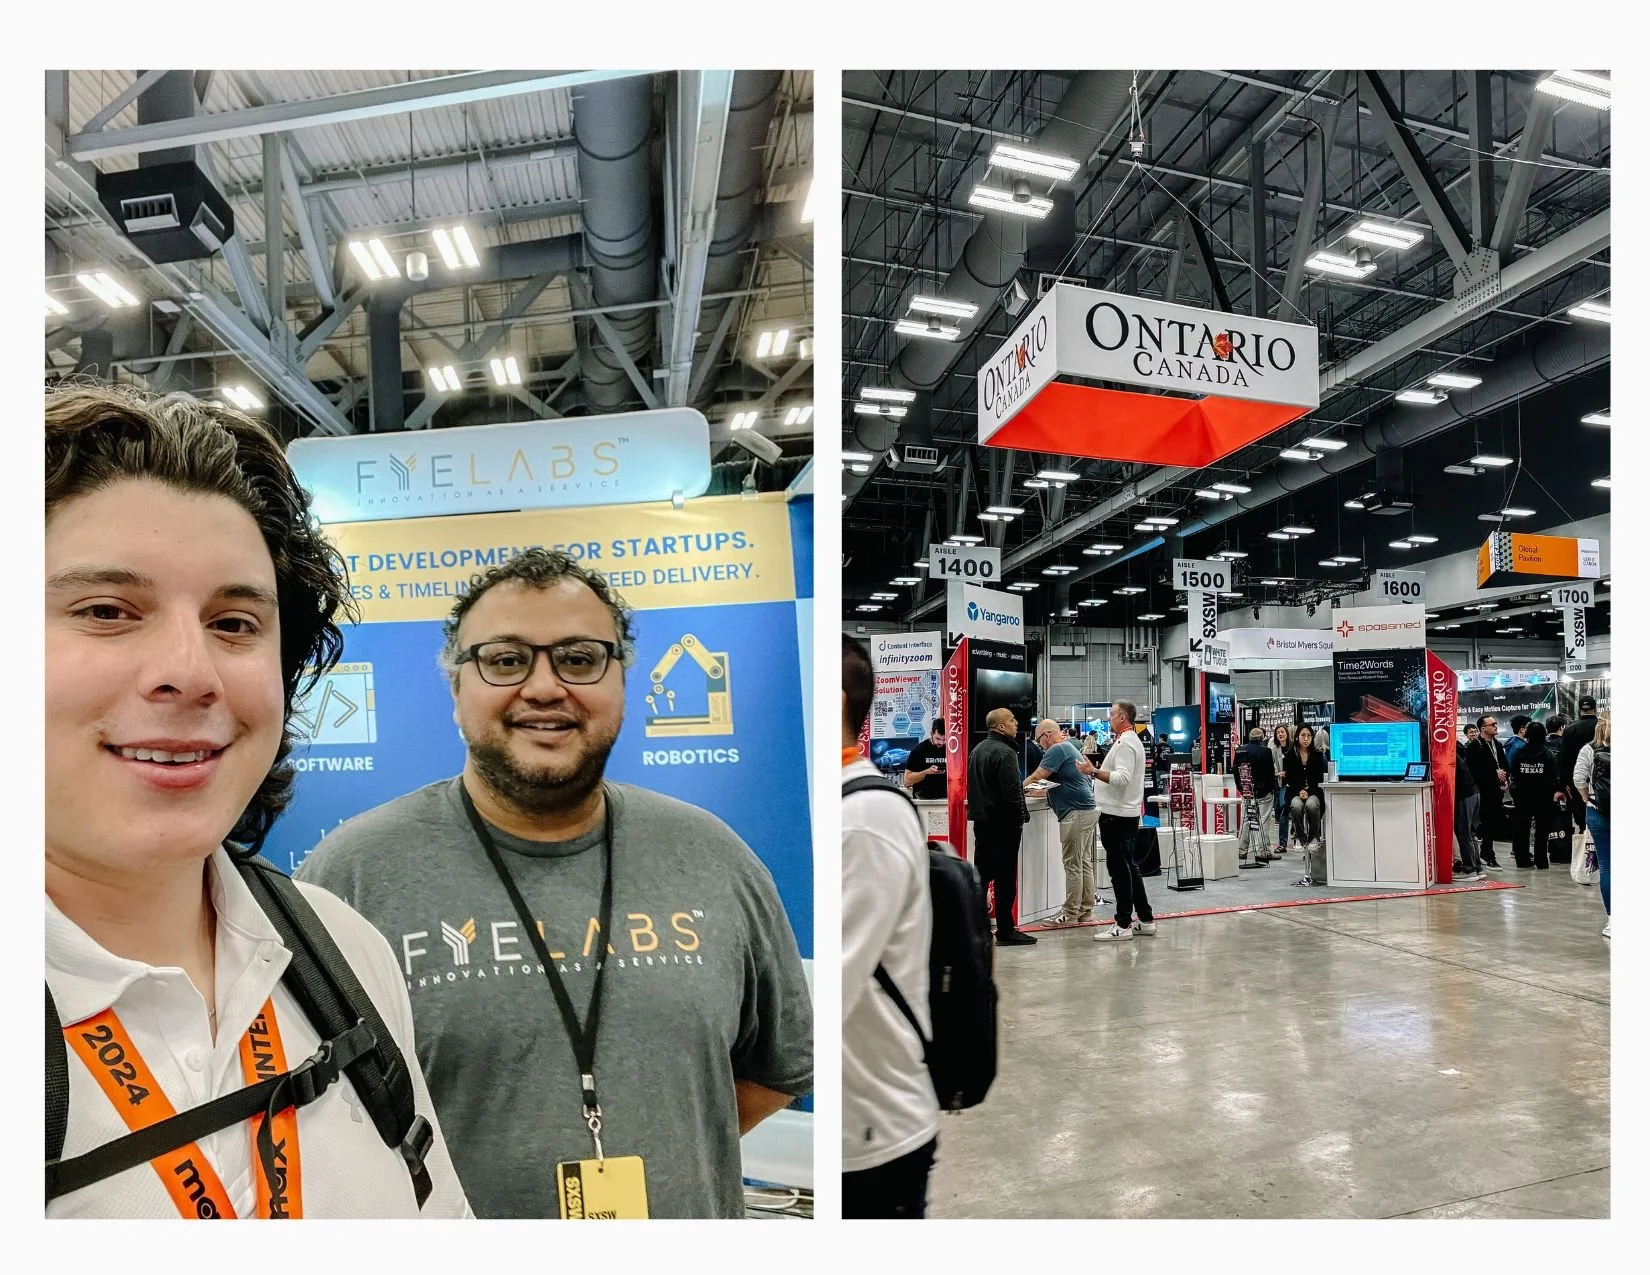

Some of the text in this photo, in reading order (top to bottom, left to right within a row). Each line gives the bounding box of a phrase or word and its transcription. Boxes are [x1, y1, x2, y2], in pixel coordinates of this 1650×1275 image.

[1085, 302, 1296, 376] ONTARIO
[984, 315, 1047, 411] ONTARIO
[1133, 352, 1250, 388] CANADA
[995, 371, 1032, 419] CANADA
[357, 490, 473, 506] INNOVATION
[487, 488, 504, 496] AS
[538, 479, 620, 493] SERVICE
[368, 545, 543, 572] DEVELOPME
[611, 531, 754, 558] STARTUPS.
[1518, 545, 1538, 553] Global
[1518, 554, 1542, 563] Pavilion
[379, 584, 391, 599] &
[396, 580, 471, 598] TIMELIN
[600, 570, 646, 587] EED
[653, 562, 760, 585] DELIVERY.
[938, 558, 993, 577] 1400
[1181, 571, 1224, 588] 1500
[1383, 581, 1421, 596] 1600
[1557, 590, 1589, 604] 1700
[980, 607, 1020, 626] Yangaroo
[1202, 592, 1216, 639] SXSW
[1358, 620, 1421, 633] spassmed
[1574, 607, 1585, 648] SXSW
[1276, 640, 1296, 649] Bristol
[1298, 641, 1318, 651] Myers
[879, 654, 933, 665] infinityzoom
[1336, 660, 1394, 670] Time2Words
[874, 686, 904, 694] Solution
[876, 675, 922, 684] ZoomViewer
[947, 664, 959, 754] ONTARIO
[954, 686, 963, 735] CANADA
[1433, 670, 1449, 743] ONTARIO
[1446, 687, 1454, 728] CANADA
[1457, 706, 1467, 714] uick
[1472, 706, 1483, 714] Easy
[1484, 705, 1501, 713] Motion
[1501, 704, 1521, 713] Capture
[1521, 703, 1529, 711] for
[1530, 702, 1551, 710] Training
[642, 747, 740, 766] ROBOTICS
[407, 963, 546, 990] INNOVATION
[559, 962, 582, 973] AS
[618, 955, 704, 969] SERVICE
[82, 1025, 150, 1106] 2024
[565, 1176, 584, 1219] SXSW
